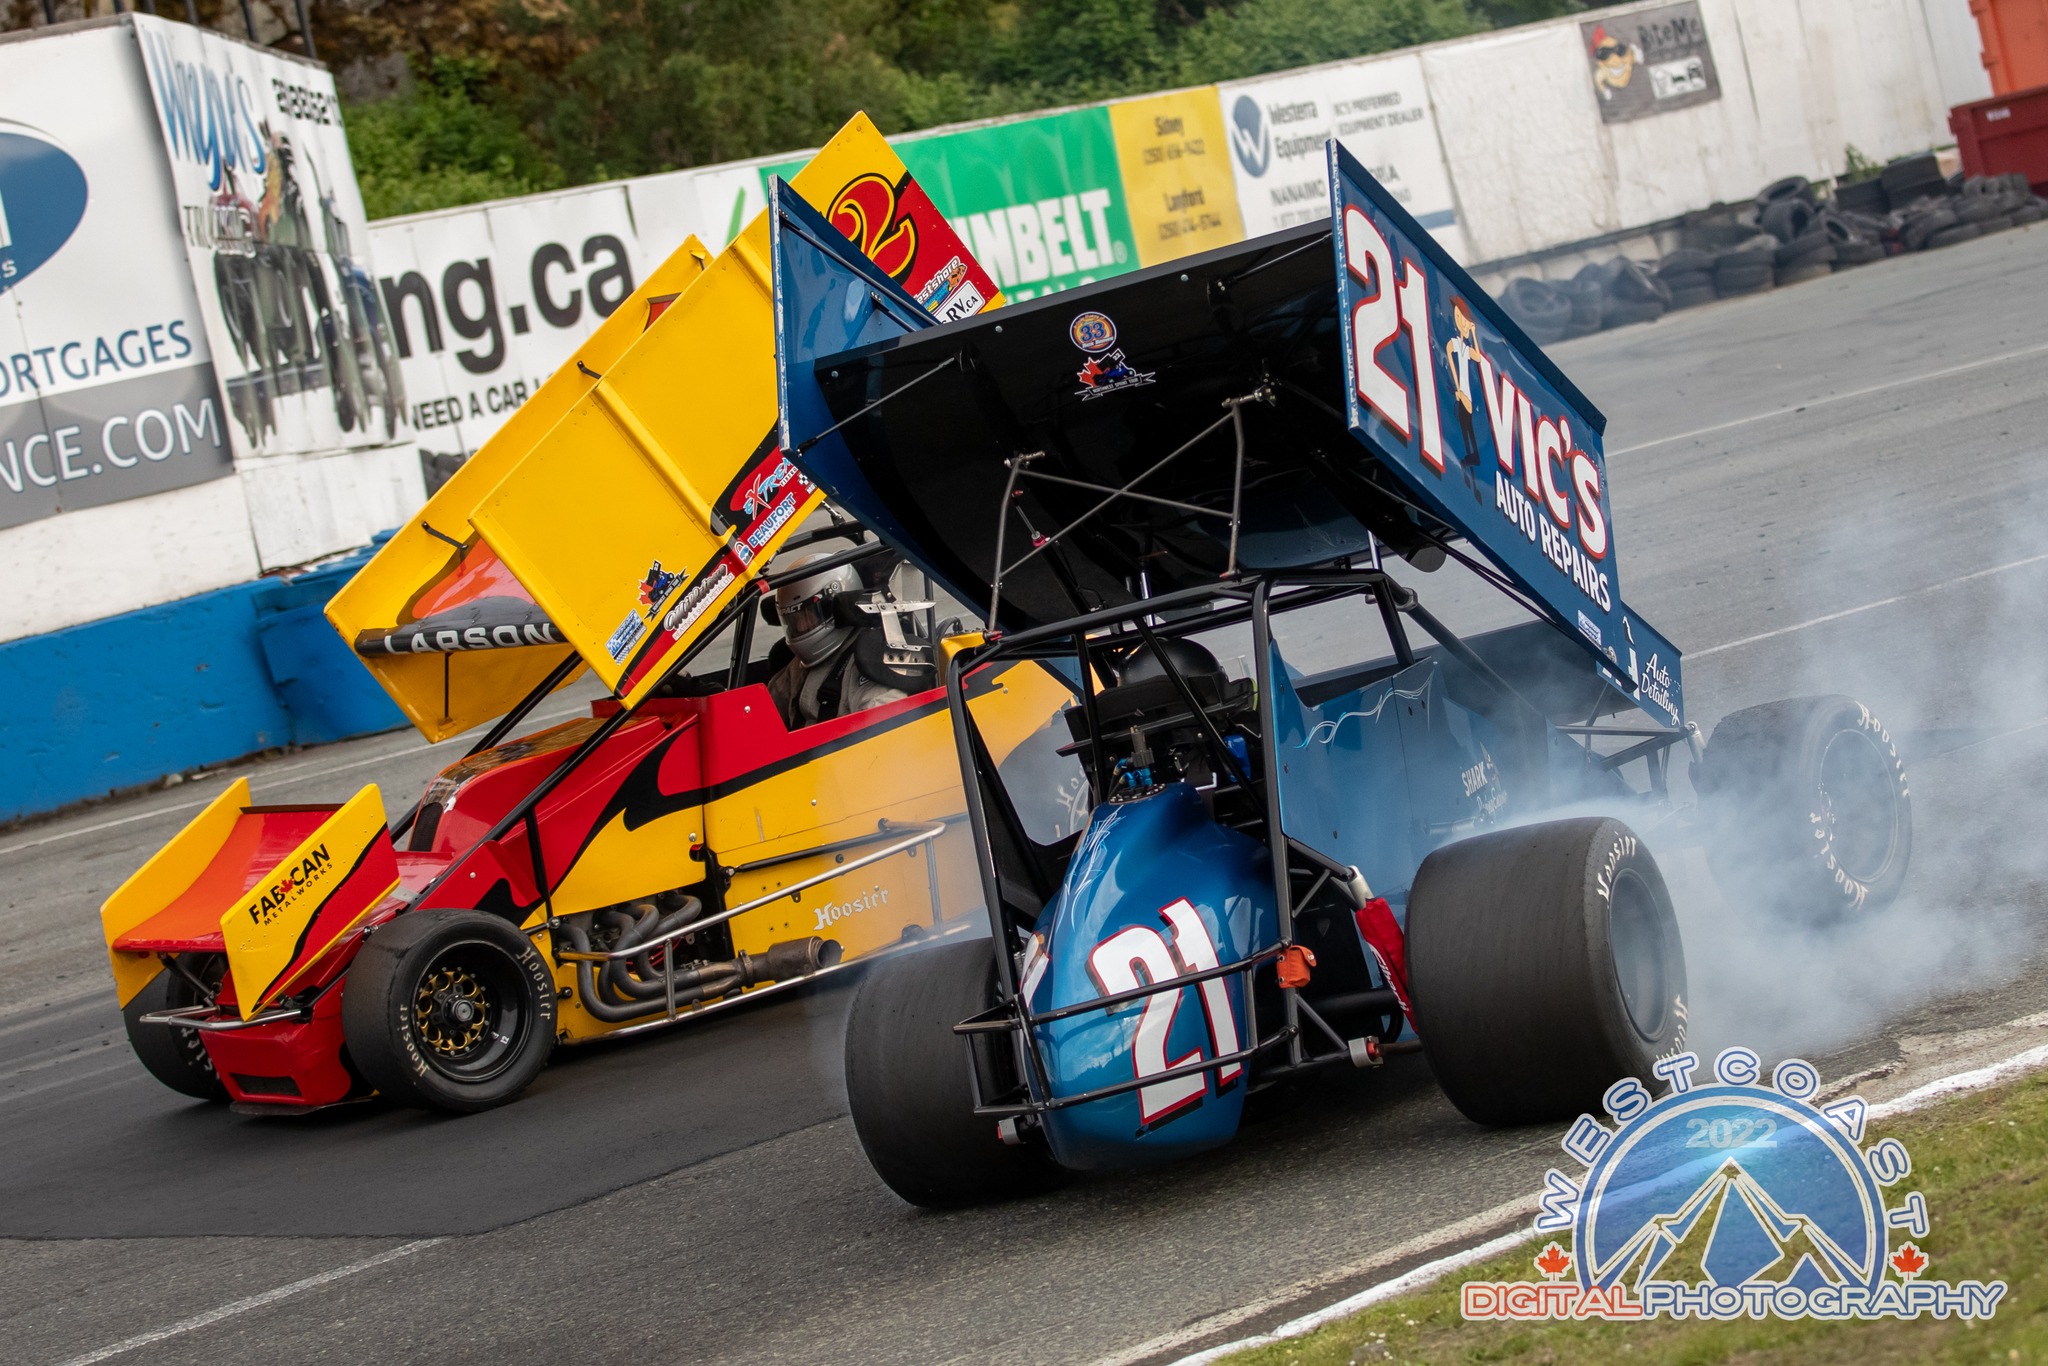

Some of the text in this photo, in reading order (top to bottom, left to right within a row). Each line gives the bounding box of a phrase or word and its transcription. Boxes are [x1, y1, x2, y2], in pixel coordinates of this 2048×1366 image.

[1388, 107, 1425, 127] DEALER
[915, 257, 960, 304] estshore
[1081, 322, 1106, 342] 33
[1344, 203, 1446, 478] 21
[469, 391, 484, 419] A
[486, 379, 528, 414] CAR
[1479, 350, 1608, 560] VIC'S
[749, 492, 796, 548] BEAUFORT
[772, 507, 794, 531] STORAGE
[1495, 470, 1612, 613] AUTO REPAIRS
[672, 616, 694, 639] HEATING
[695, 598, 711, 614] SHEET
[708, 583, 725, 600] METAL
[780, 602, 803, 616] PACT
[384, 622, 559, 656] LARSON
[1645, 652, 1671, 688] Auto
[1641, 672, 1681, 726] Detailing
[1461, 761, 1489, 797] SHARK
[248, 843, 331, 925] FAB CAN
[263, 862, 333, 926] METALWORKS
[812, 886, 890, 932] Hoosier
[516, 946, 553, 1021] Hoosier
[1086, 895, 1244, 1130] 21
[399, 1003, 432, 1078] Hoosier
